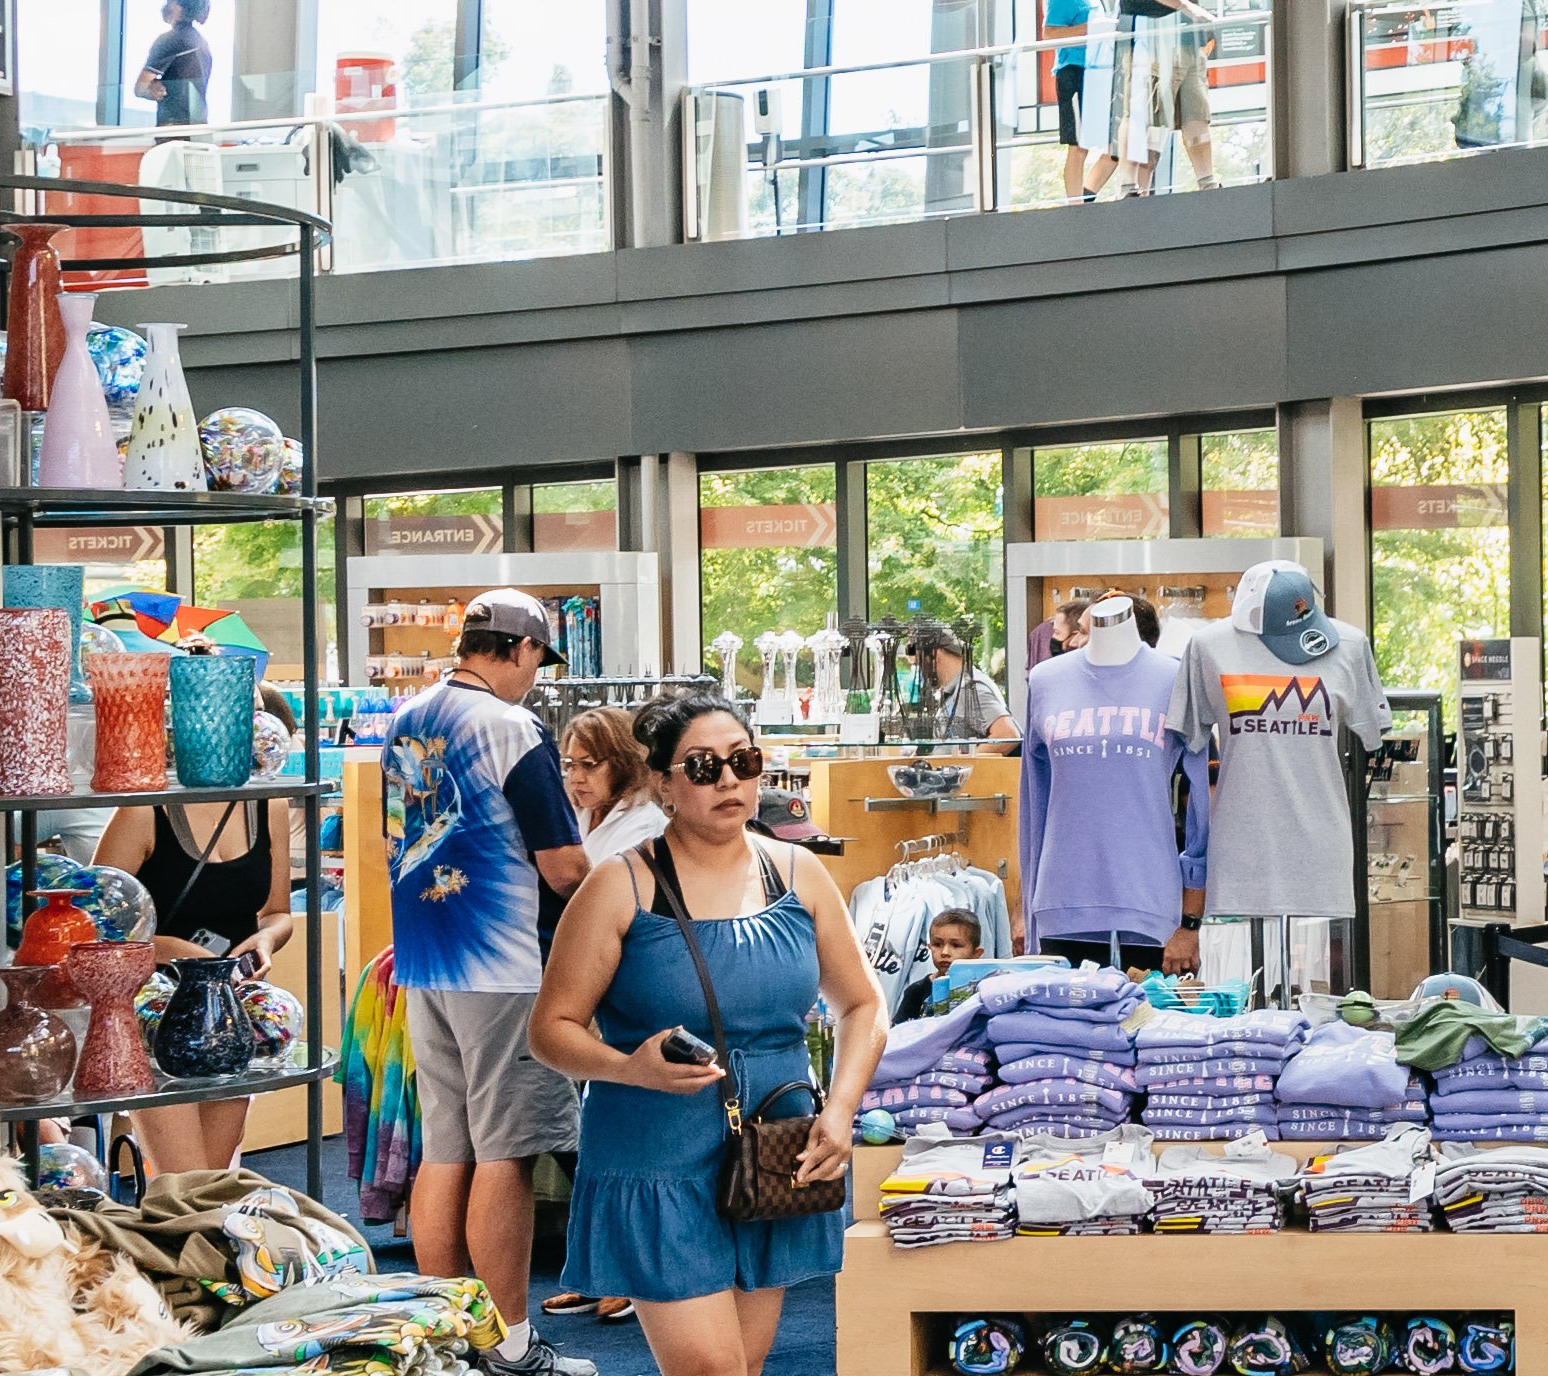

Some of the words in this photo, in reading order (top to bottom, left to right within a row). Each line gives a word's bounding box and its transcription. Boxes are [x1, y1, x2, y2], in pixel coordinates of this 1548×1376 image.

[1053, 744, 1094, 758] SINCE
[1115, 744, 1151, 759] 1851
[995, 985, 1038, 1006] SINCE
[1008, 1058, 1055, 1070] SINCE
[1149, 1063, 1195, 1076] SINCE
[991, 1094, 1035, 1114] SINCE
[1152, 1094, 1199, 1107] SINCE
[1147, 1108, 1193, 1119] SINCE
[1017, 1125, 1055, 1140] INCE
[1155, 1129, 1201, 1140] SINCE
[1290, 1121, 1336, 1132] SINCE
[1358, 1122, 1387, 1135] 185
